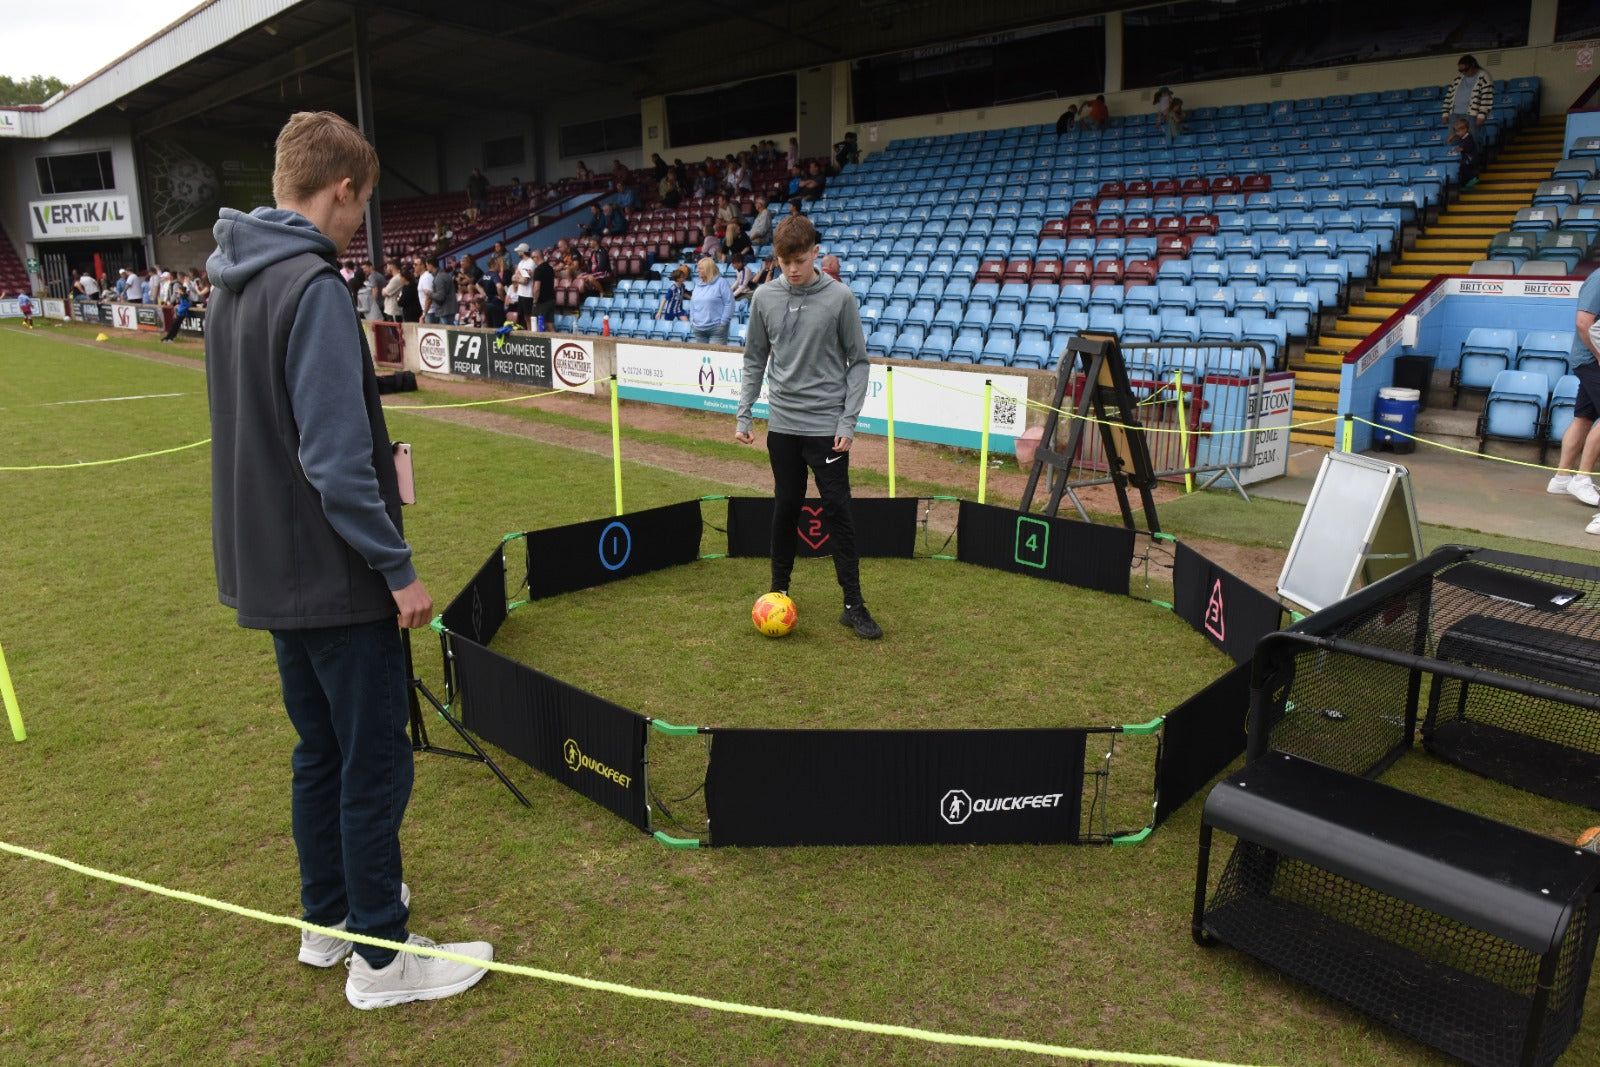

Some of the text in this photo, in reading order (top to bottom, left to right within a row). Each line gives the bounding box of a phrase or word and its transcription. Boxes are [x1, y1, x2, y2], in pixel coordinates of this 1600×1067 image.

[1460, 283, 1504, 291] BRITCON
[1524, 284, 1571, 293] BRITCON
[453, 334, 482, 360] FA
[562, 349, 584, 361] MJB
[454, 361, 481, 375] PREP UK
[494, 360, 514, 374] PREP
[514, 362, 546, 378] CENTRE
[809, 519, 822, 536] 2
[1025, 533, 1039, 552] 4
[1209, 599, 1219, 623] 3
[582, 754, 632, 789] QUICKFEET
[972, 793, 1064, 812] QUICKFEET
